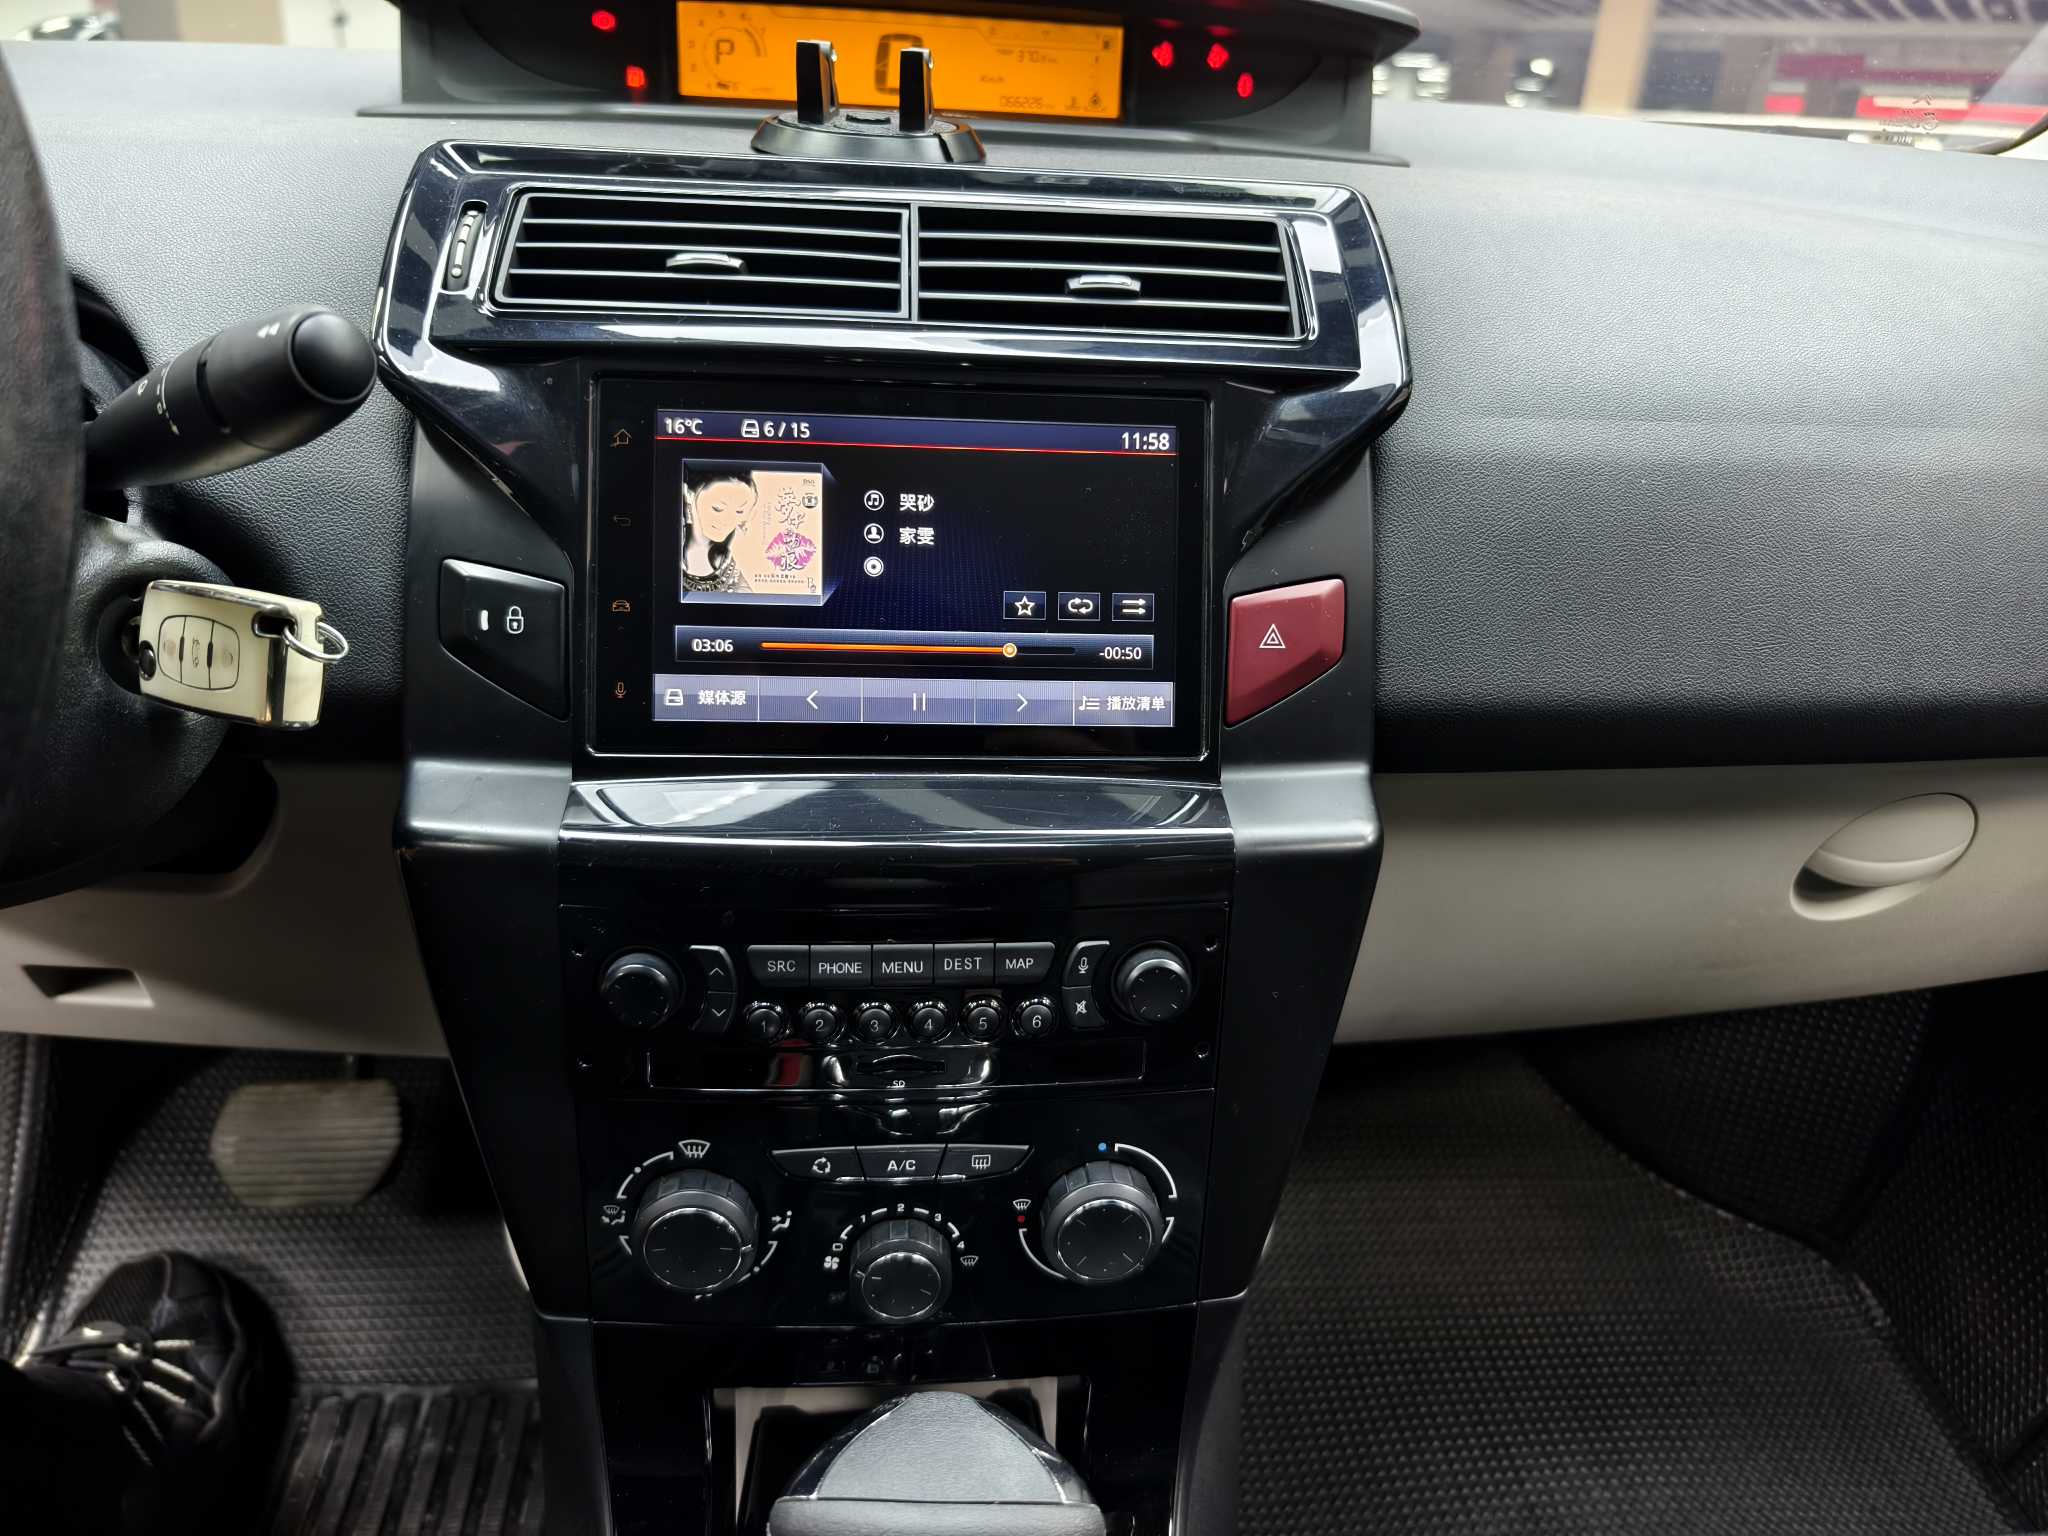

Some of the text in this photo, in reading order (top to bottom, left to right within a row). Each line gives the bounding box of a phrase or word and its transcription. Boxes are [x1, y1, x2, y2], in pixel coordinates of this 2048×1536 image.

[1121, 431, 1170, 450] 11:58
[899, 493, 935, 512] 哭砂
[691, 638, 734, 653] 03:06
[1099, 646, 1142, 660] -00:50
[698, 689, 747, 706] 媒体源
[1106, 695, 1166, 711] 播放清单
[767, 960, 796, 973] SRC
[818, 962, 863, 975] PHONE
[882, 960, 924, 974] MENU
[943, 957, 983, 971] DEST
[1005, 957, 1034, 970] MAP
[761, 1020, 767, 1033] 1
[815, 1019, 825, 1032] 2
[870, 1020, 880, 1033] 3
[924, 1018, 933, 1031] 4
[978, 1017, 988, 1031] 5
[1032, 1015, 1042, 1029] 6
[892, 1079, 906, 1088] SD
[887, 1159, 916, 1172] A/C
[896, 1203, 905, 1213] 2
[860, 1213, 867, 1223] 1
[934, 1213, 942, 1223] 3
[956, 1240, 965, 1250] 4
